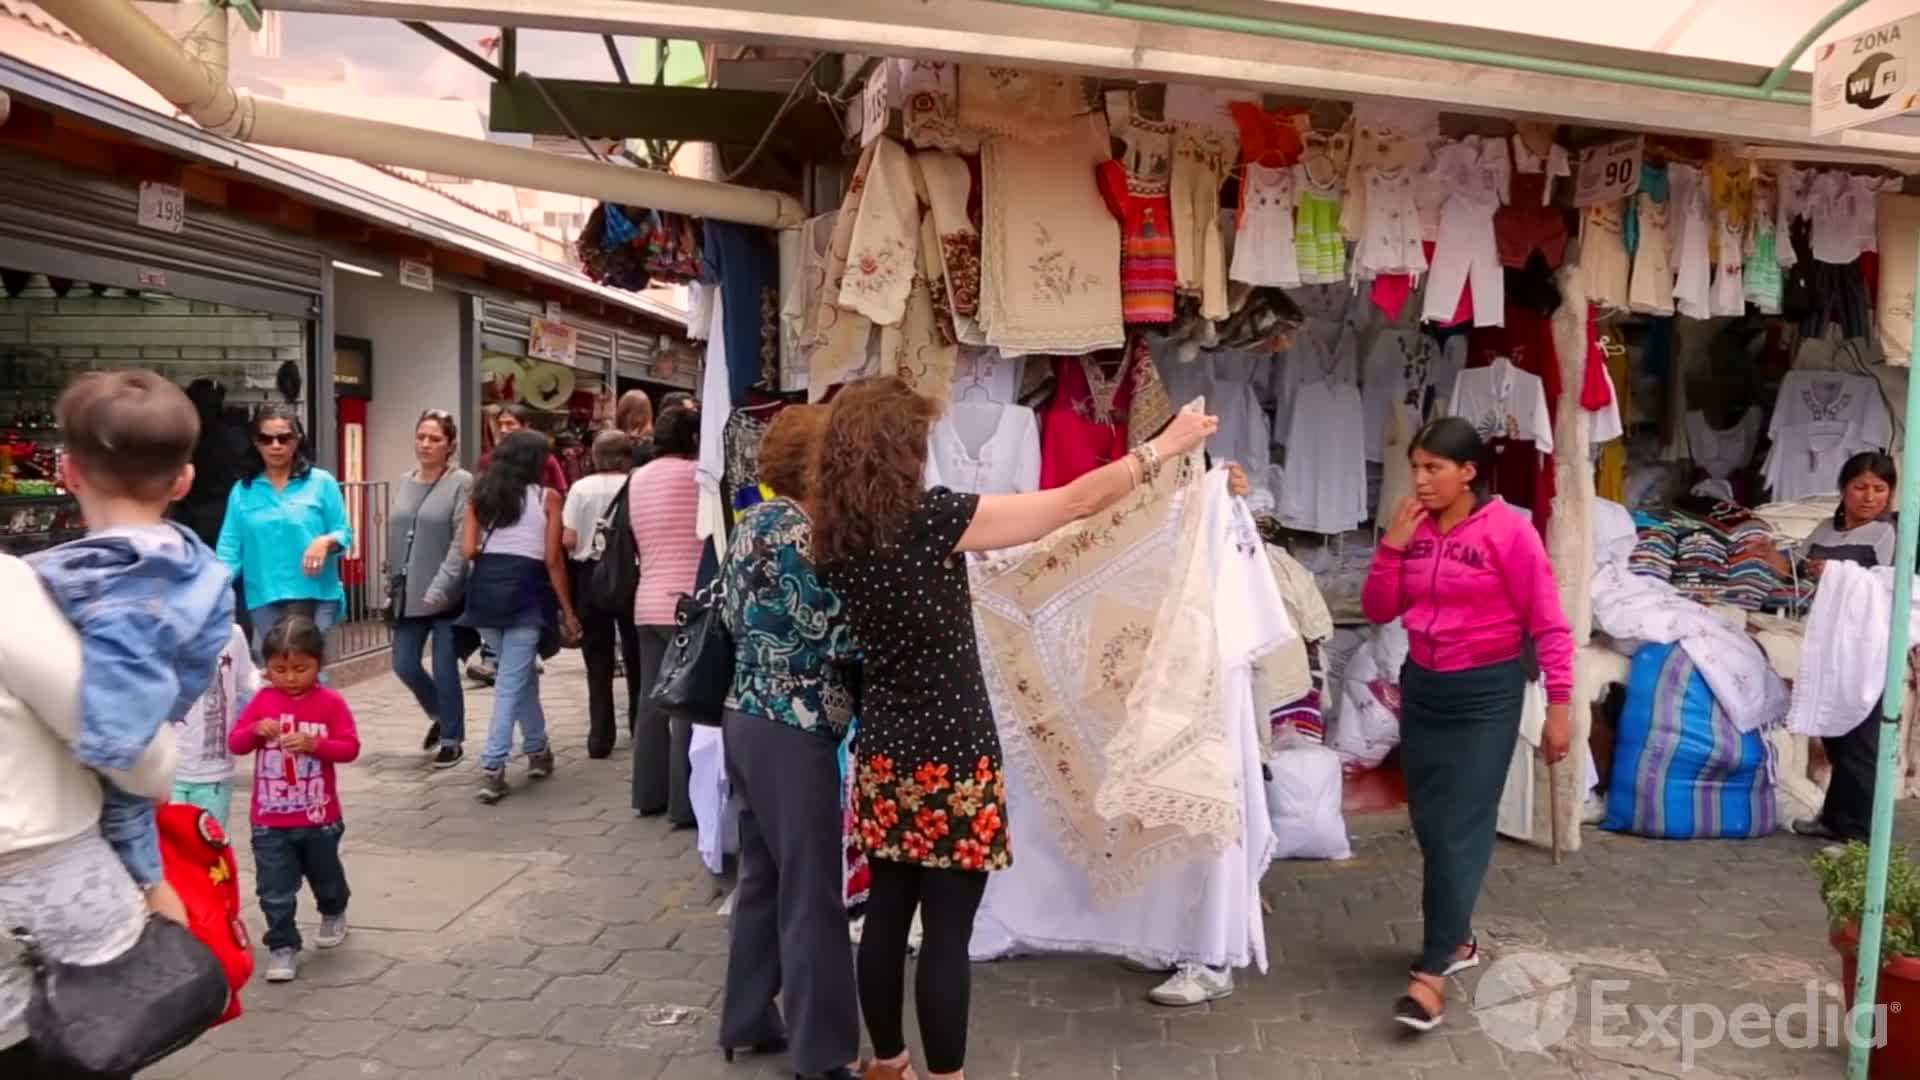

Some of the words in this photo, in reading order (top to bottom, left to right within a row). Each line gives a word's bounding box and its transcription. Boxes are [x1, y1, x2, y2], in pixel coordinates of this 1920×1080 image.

[1853, 25, 1901, 55] ZONA
[1604, 158, 1633, 188] 90
[154, 199, 182, 224] 198
